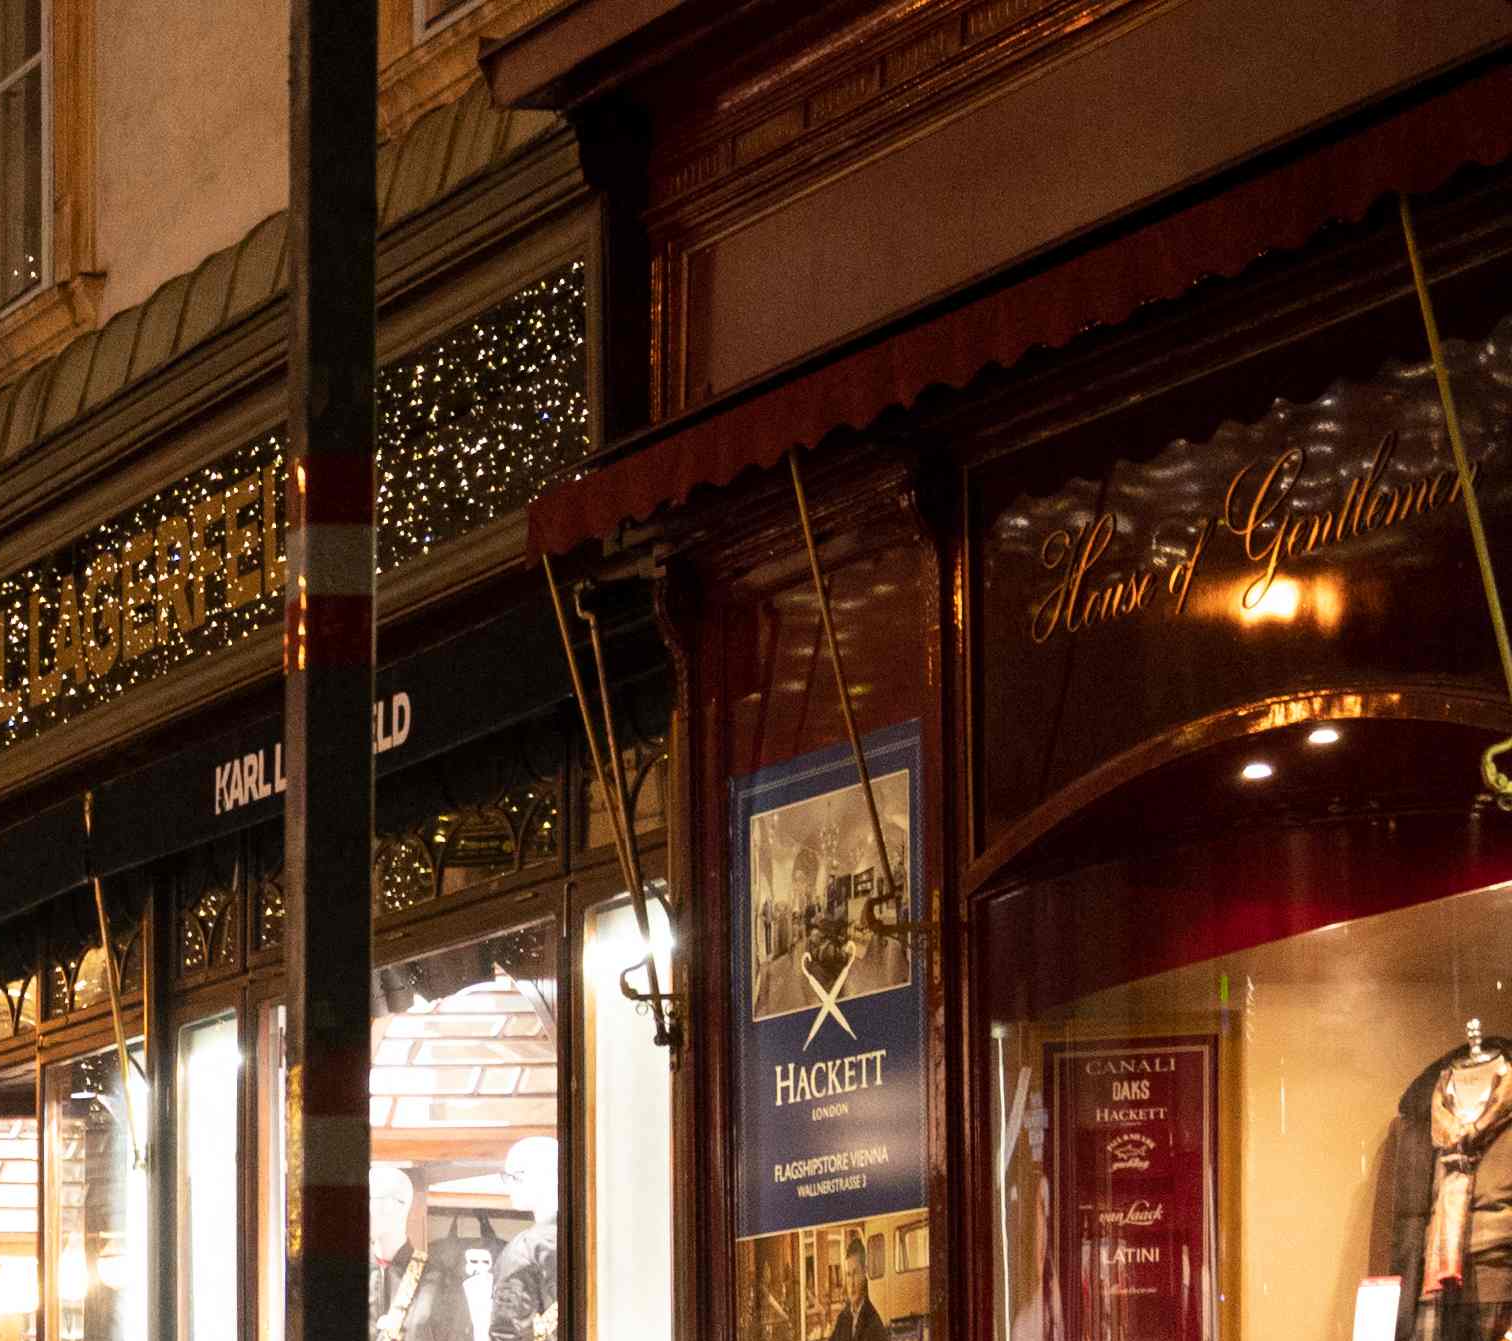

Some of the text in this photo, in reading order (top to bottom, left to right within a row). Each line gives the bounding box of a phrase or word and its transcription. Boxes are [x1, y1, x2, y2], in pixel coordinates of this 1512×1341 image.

[1032, 430, 1483, 645] House of Gentlemen
[27, 461, 287, 707] LAGERFEL
[214, 751, 273, 816] KARL
[775, 1049, 887, 1106] HACKETT
[1086, 1057, 1176, 1075] CANALI
[812, 1104, 848, 1121] LONDON
[1096, 1108, 1168, 1122] HACKETT
[775, 1144, 889, 1182] FLAGSHIPSTORE VIENNA
[797, 1178, 862, 1197] WALLNERSTRASSE
[1102, 1248, 1160, 1264] LATINI
